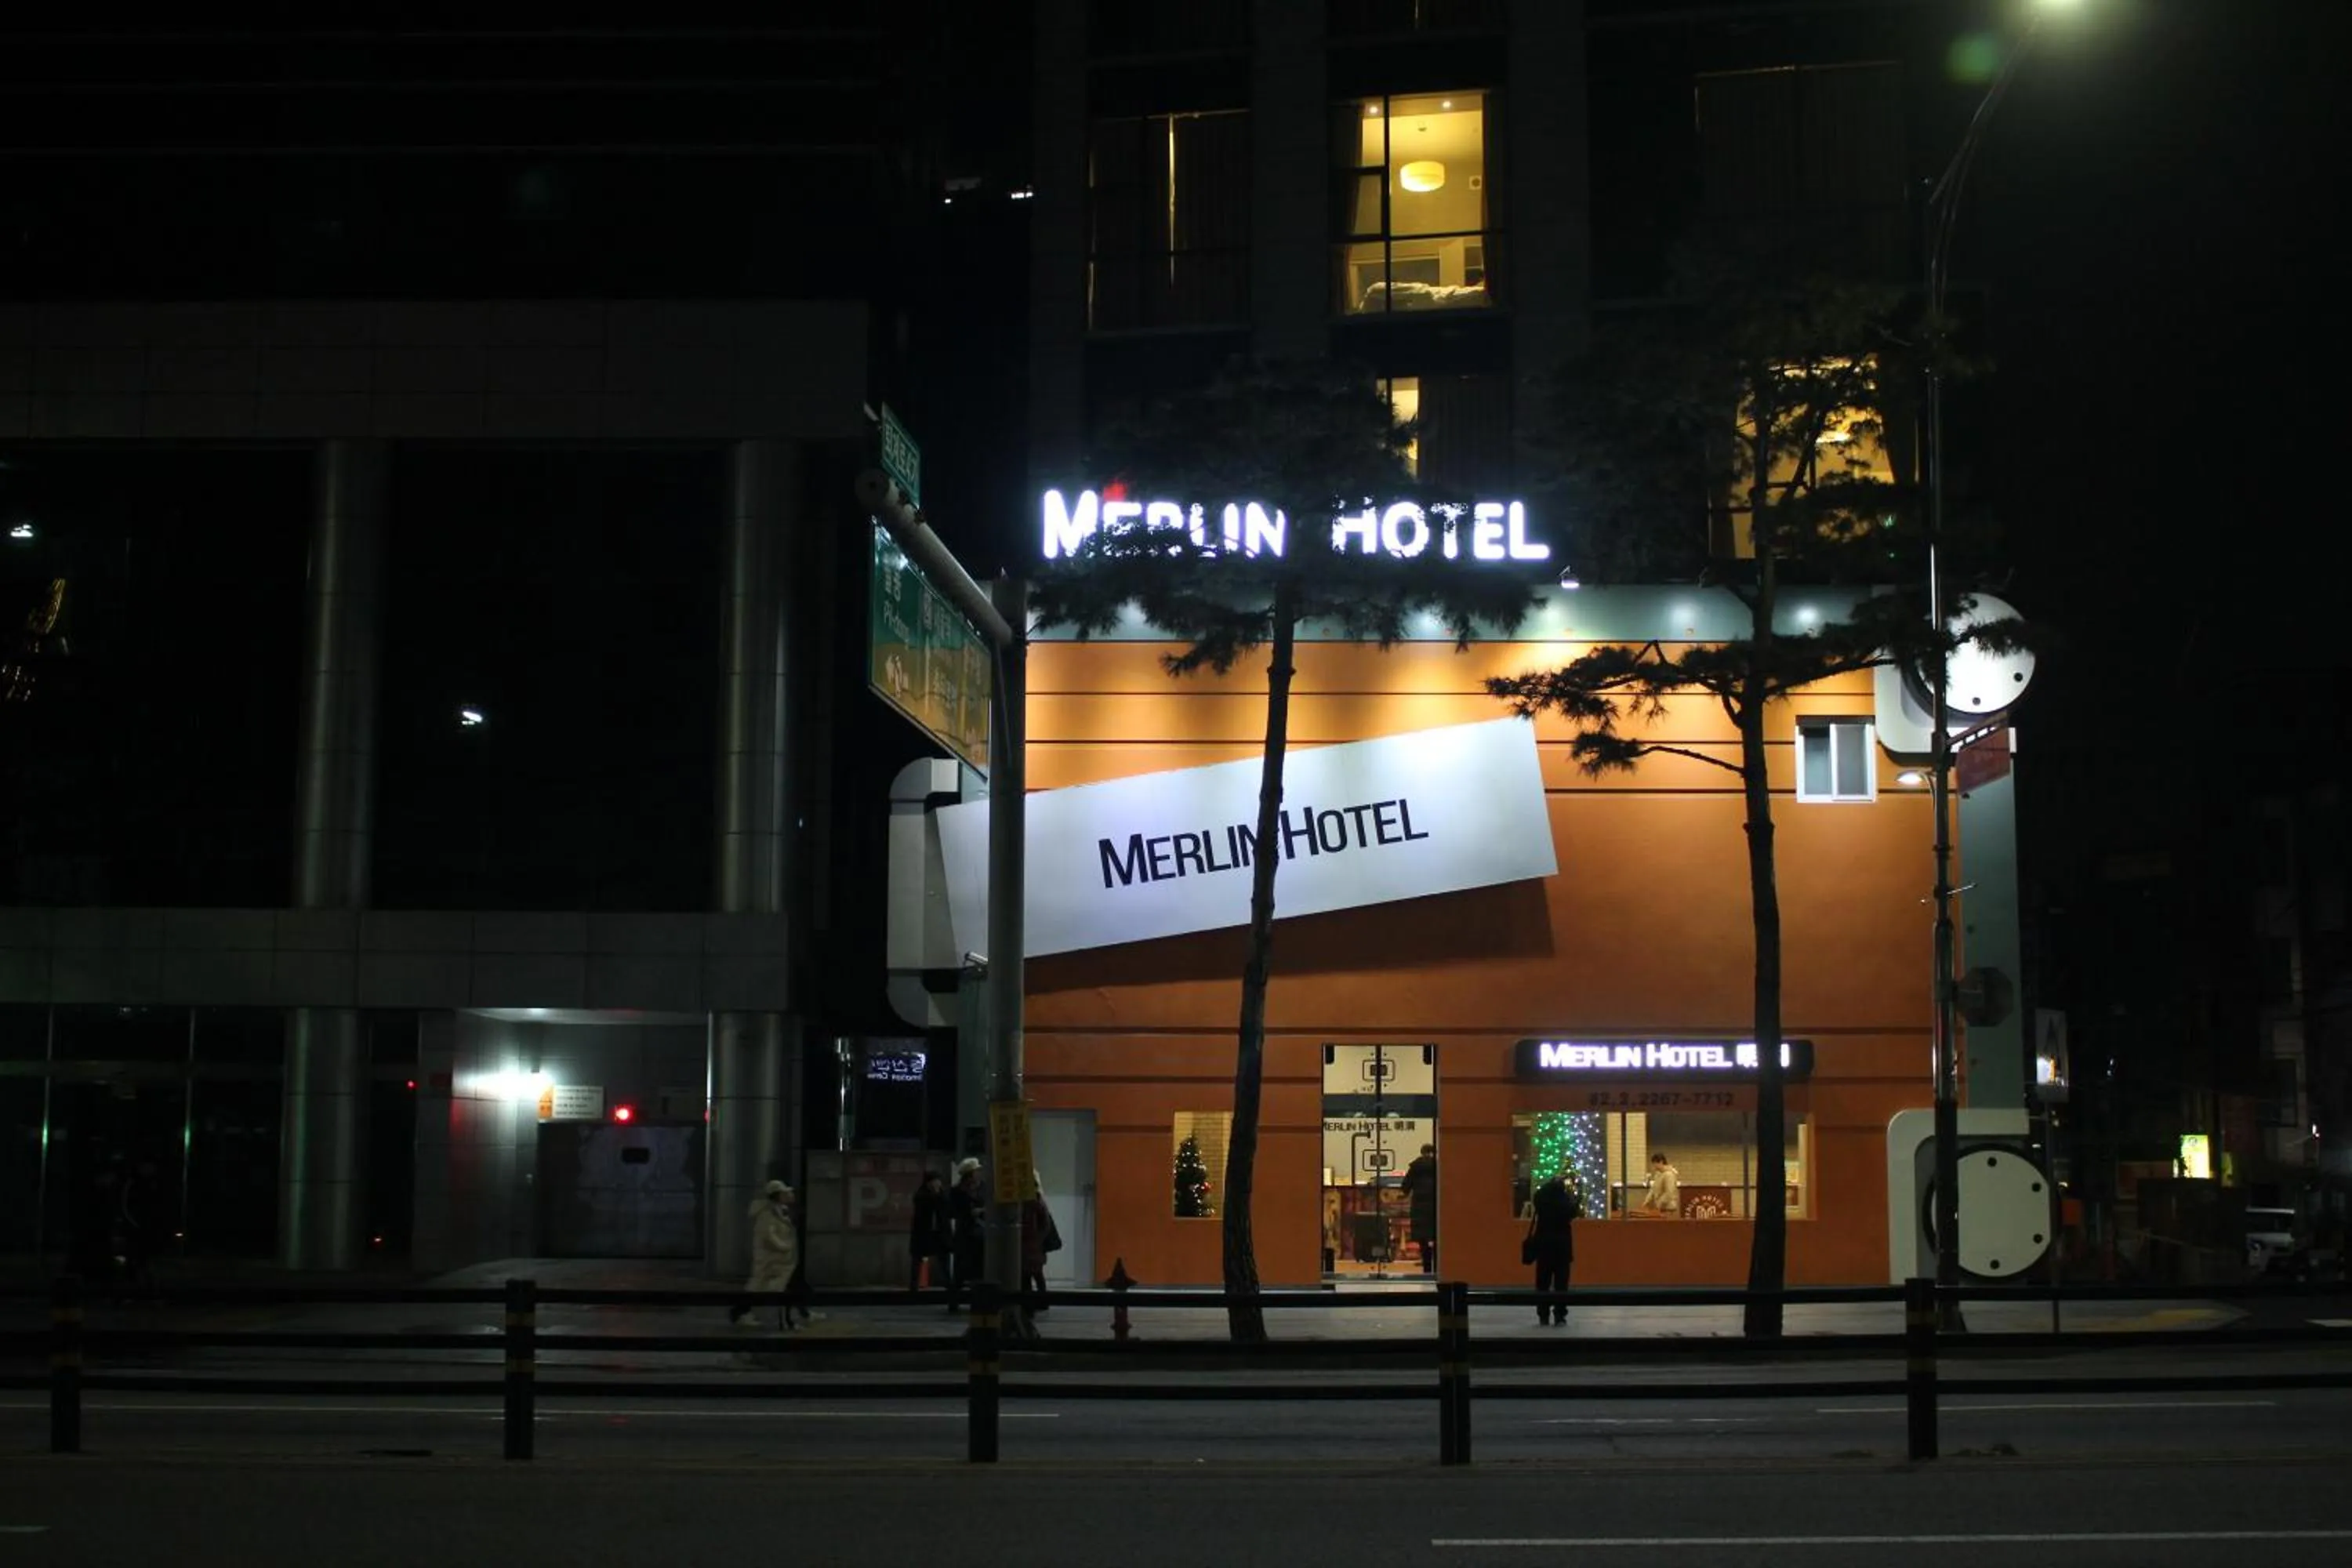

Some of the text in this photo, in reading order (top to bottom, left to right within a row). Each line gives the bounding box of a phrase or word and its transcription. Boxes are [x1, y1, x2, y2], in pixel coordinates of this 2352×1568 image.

[1332, 495, 1550, 560] HOTEL
[1280, 798, 1429, 859] HOTEL
[1541, 1044, 1642, 1067] MERLIN
[1646, 1044, 1733, 1067] HOTEL
[848, 1177, 888, 1229] P
